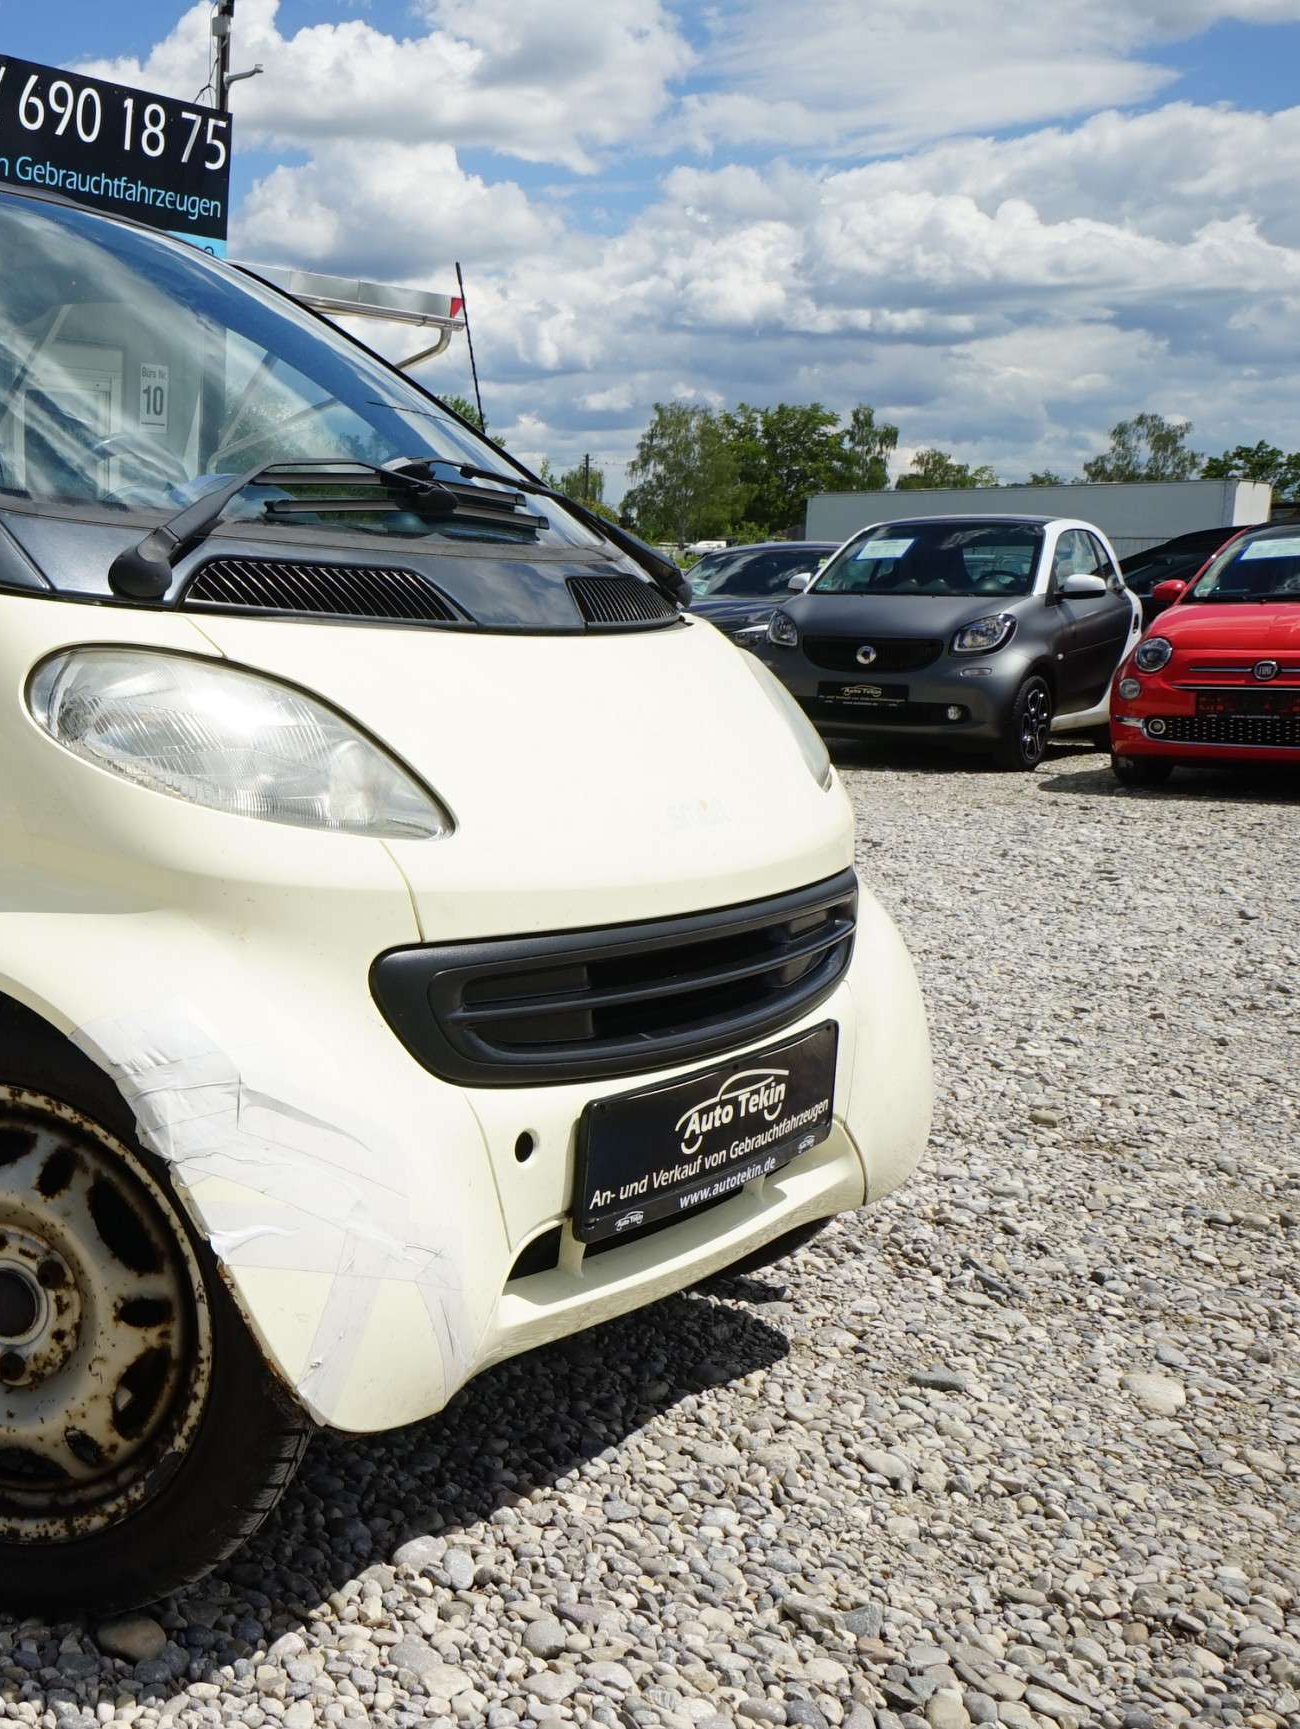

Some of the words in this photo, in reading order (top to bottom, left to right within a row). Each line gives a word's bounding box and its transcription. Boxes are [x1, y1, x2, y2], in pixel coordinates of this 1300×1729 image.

[18, 74, 102, 143] 690
[123, 97, 166, 158] 18
[180, 111, 228, 171] 75
[16, 156, 222, 220] Gebrauchtfahrzeugen
[143, 385, 164, 416] 10
[683, 1103, 734, 1140] Auto
[738, 1081, 787, 1118] Tekin
[589, 1189, 616, 1210] An-
[619, 1174, 649, 1200] und
[652, 1155, 703, 1189] Verkauf
[704, 1149, 727, 1170] von
[729, 1098, 829, 1159] Gebrauchtfahrzeugen
[679, 1156, 776, 1209] www.autotekin.de
